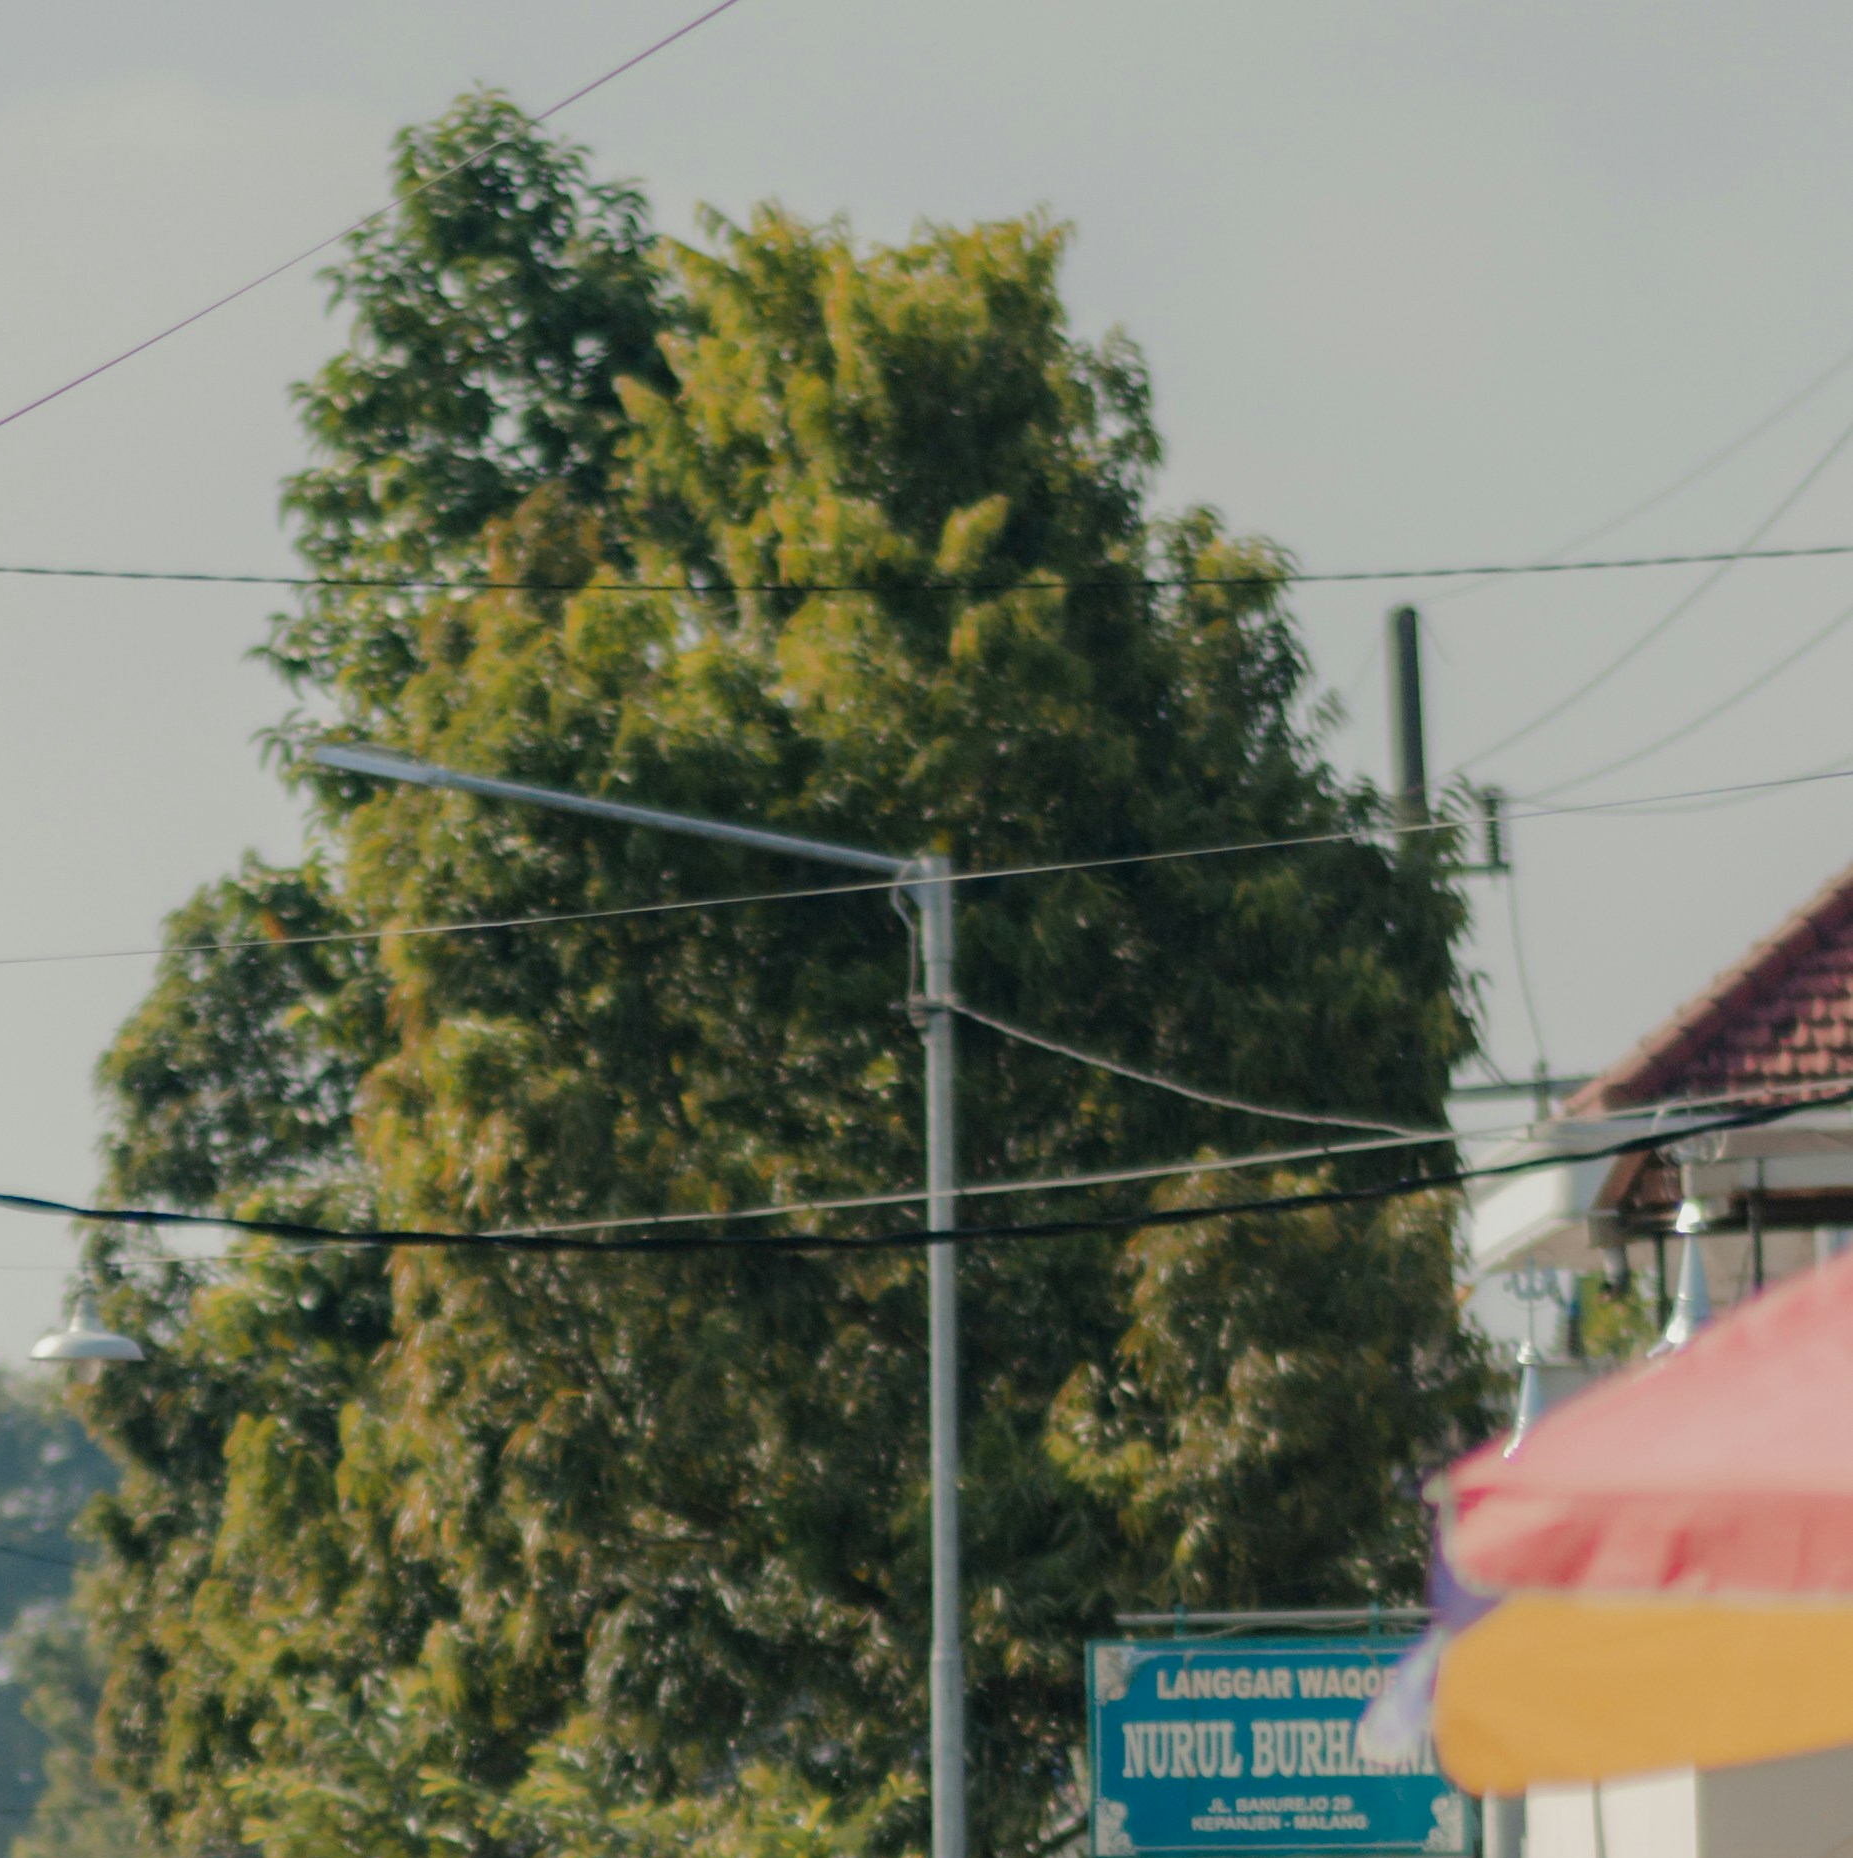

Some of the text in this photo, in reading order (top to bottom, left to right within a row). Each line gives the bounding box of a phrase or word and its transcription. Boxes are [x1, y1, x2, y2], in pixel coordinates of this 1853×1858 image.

[1157, 1669, 1292, 1700] LANGGAR
[1122, 1719, 1243, 1778] NURUL
[1235, 1795, 1329, 1813] BANUREJO
[1191, 1815, 1281, 1831] KEPANJEN
[1293, 1813, 1369, 1830] MALANG
